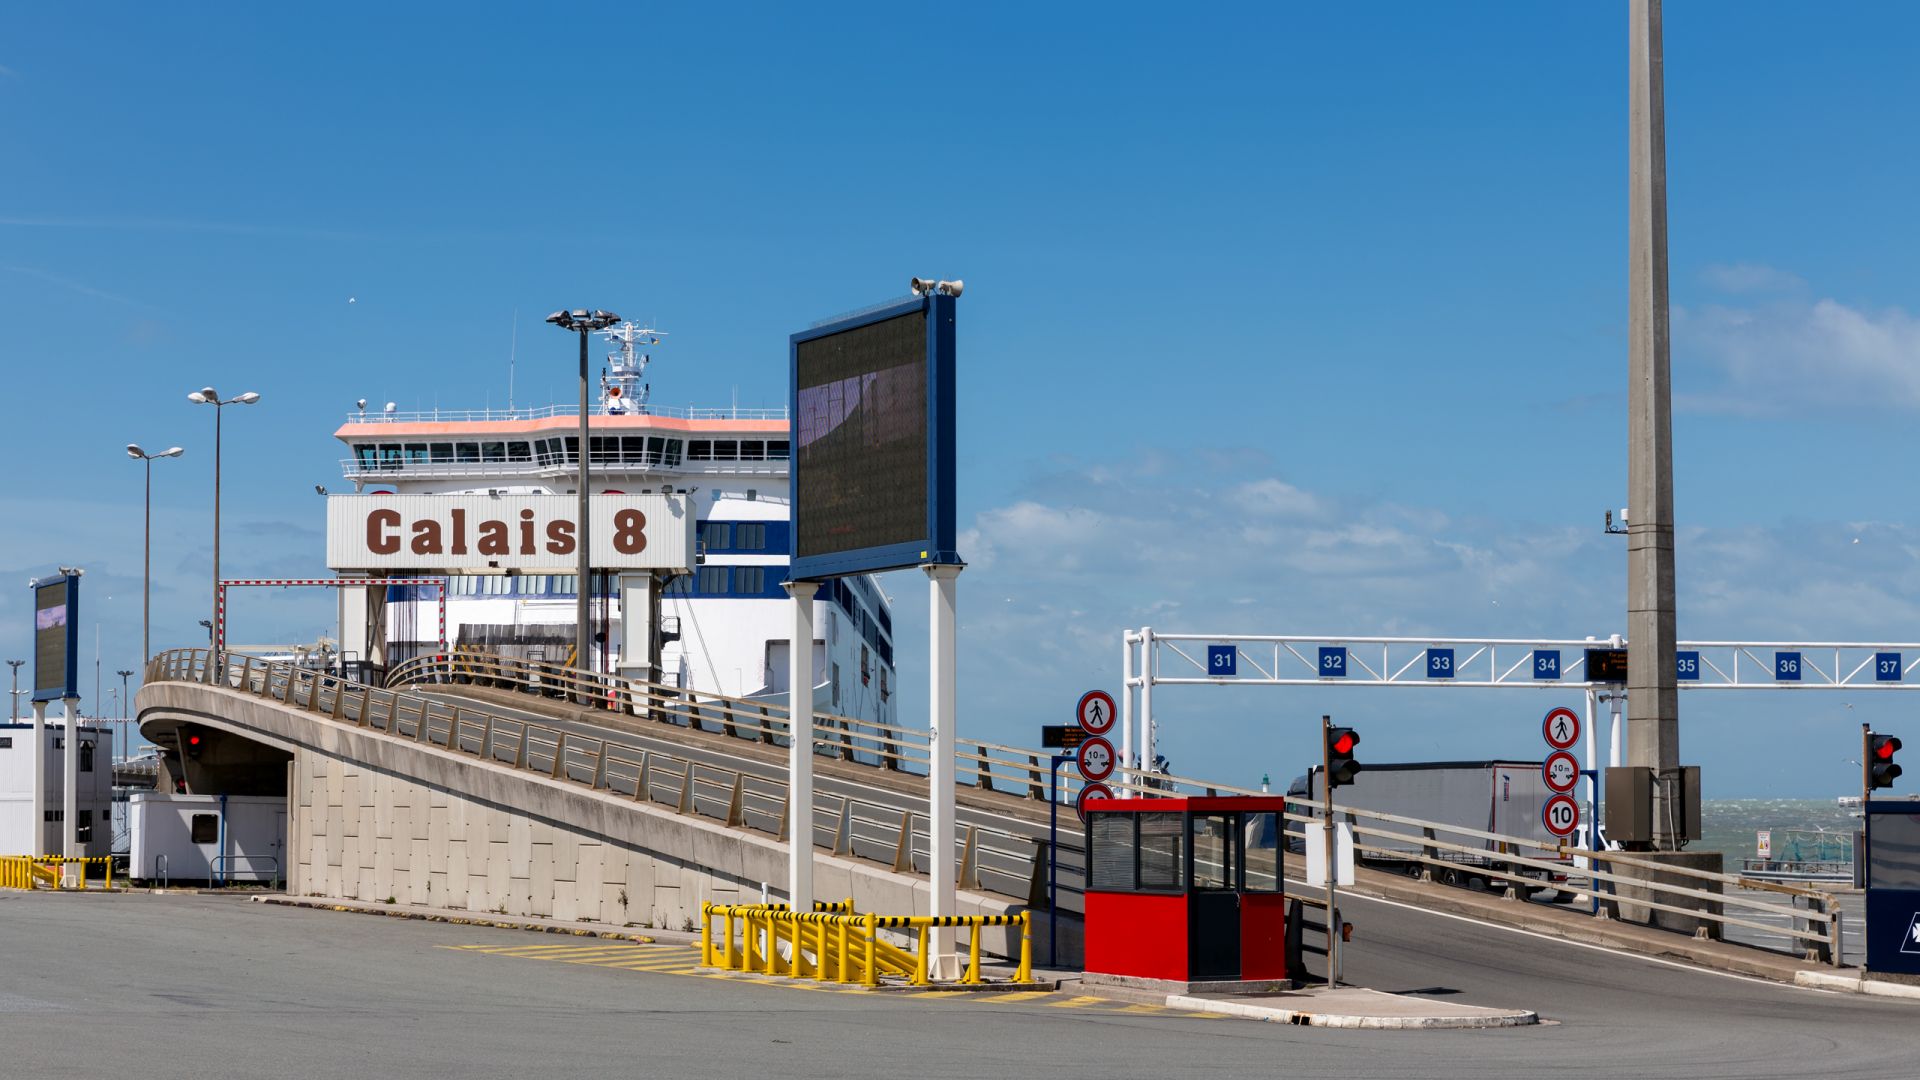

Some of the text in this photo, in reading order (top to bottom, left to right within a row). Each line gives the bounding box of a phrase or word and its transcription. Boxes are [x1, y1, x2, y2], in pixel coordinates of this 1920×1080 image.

[367, 508, 648, 556] Calais 8
[1214, 654, 1231, 667] 31
[1324, 655, 1342, 668] 32
[1432, 657, 1451, 670] 33
[1538, 658, 1556, 671] 34
[1678, 659, 1695, 672] 35
[1781, 660, 1797, 672] 36
[1881, 661, 1897, 673] 37
[1088, 750, 1099, 760] 10
[1553, 763, 1564, 773] 10
[1552, 806, 1572, 824] 10
